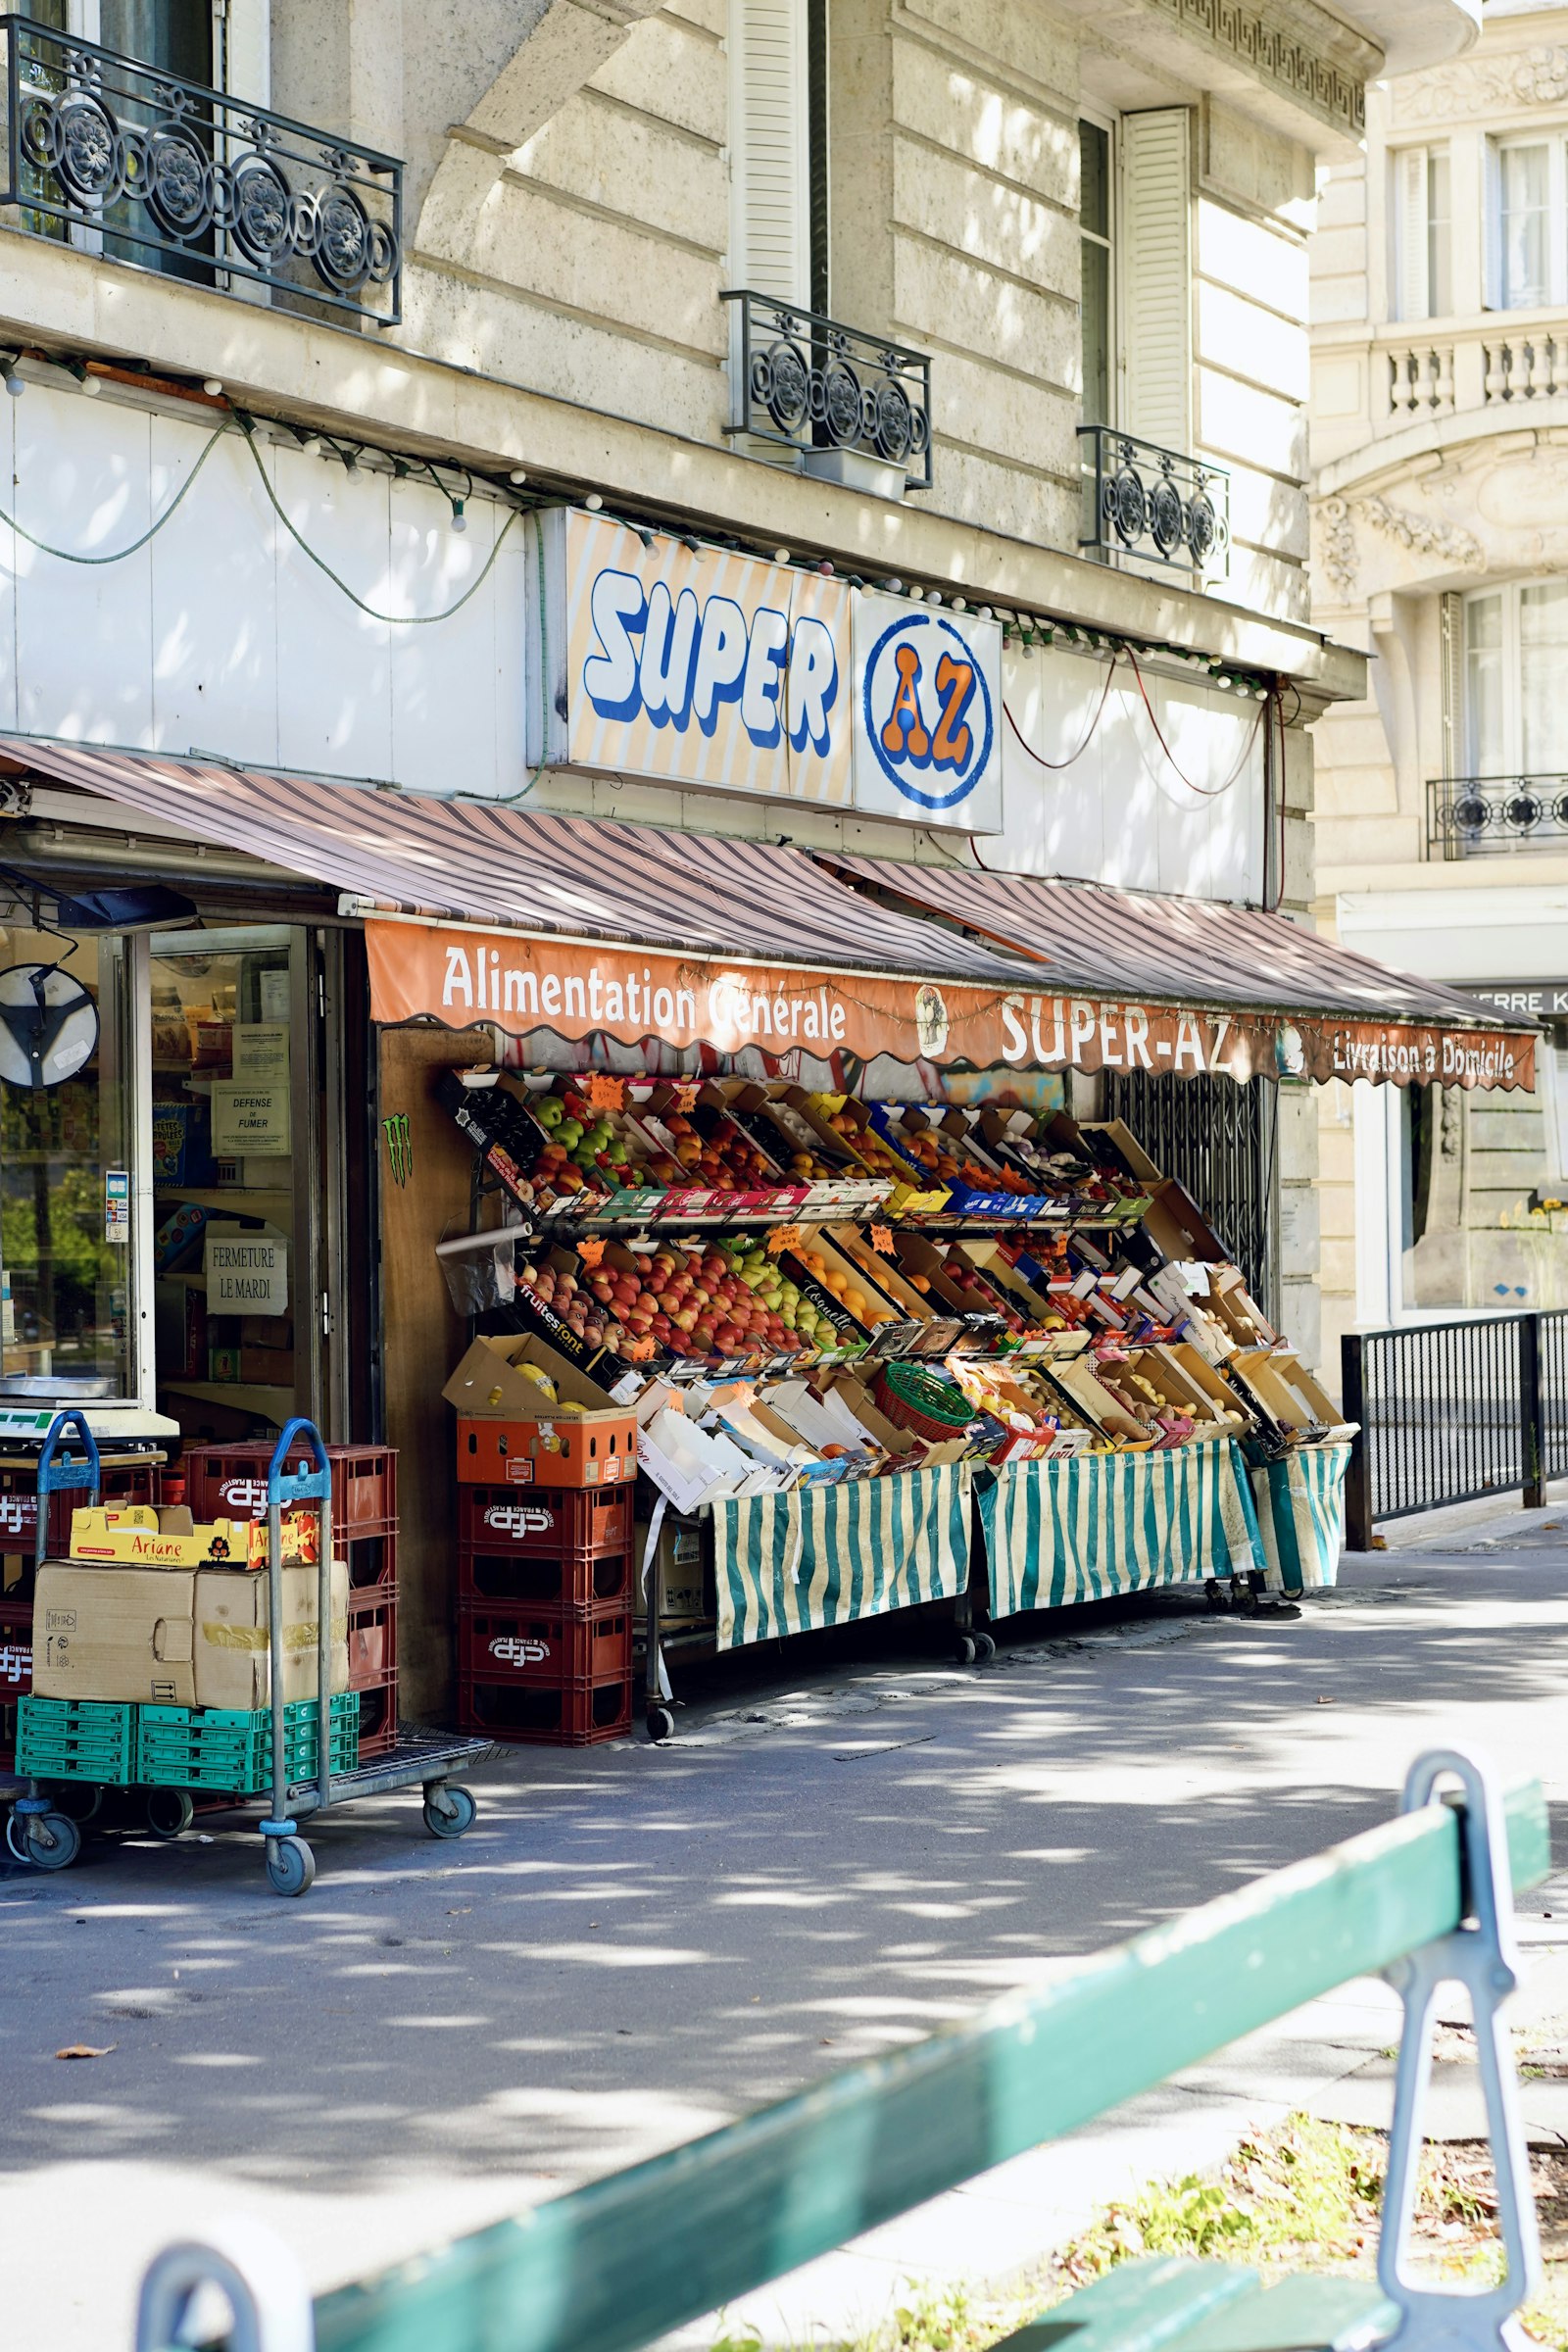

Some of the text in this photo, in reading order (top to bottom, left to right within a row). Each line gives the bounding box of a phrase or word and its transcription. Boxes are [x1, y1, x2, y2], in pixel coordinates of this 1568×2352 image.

[584, 568, 839, 758] SUPER
[881, 642, 975, 777] AZ
[442, 946, 846, 1041] Alimentation Générale
[1001, 992, 1237, 1076] SUPER-AZ
[1334, 1030, 1514, 1080] Livraison à Domicile
[233, 1098, 272, 1107] DEFENSE
[238, 1119, 269, 1128] FUMER
[213, 1247, 274, 1268] FERMETURE
[220, 1278, 270, 1298] LE MARDI
[218, 1478, 245, 1497] PLASTIQUE
[483, 1505, 506, 1524] PLASTIQUE
[489, 1506, 549, 1539] cfp
[131, 1536, 182, 1557] Ariane
[255, 1531, 293, 1547] Arne
[8, 1645, 29, 1654] FRANCE
[493, 1638, 545, 1667] cfp
